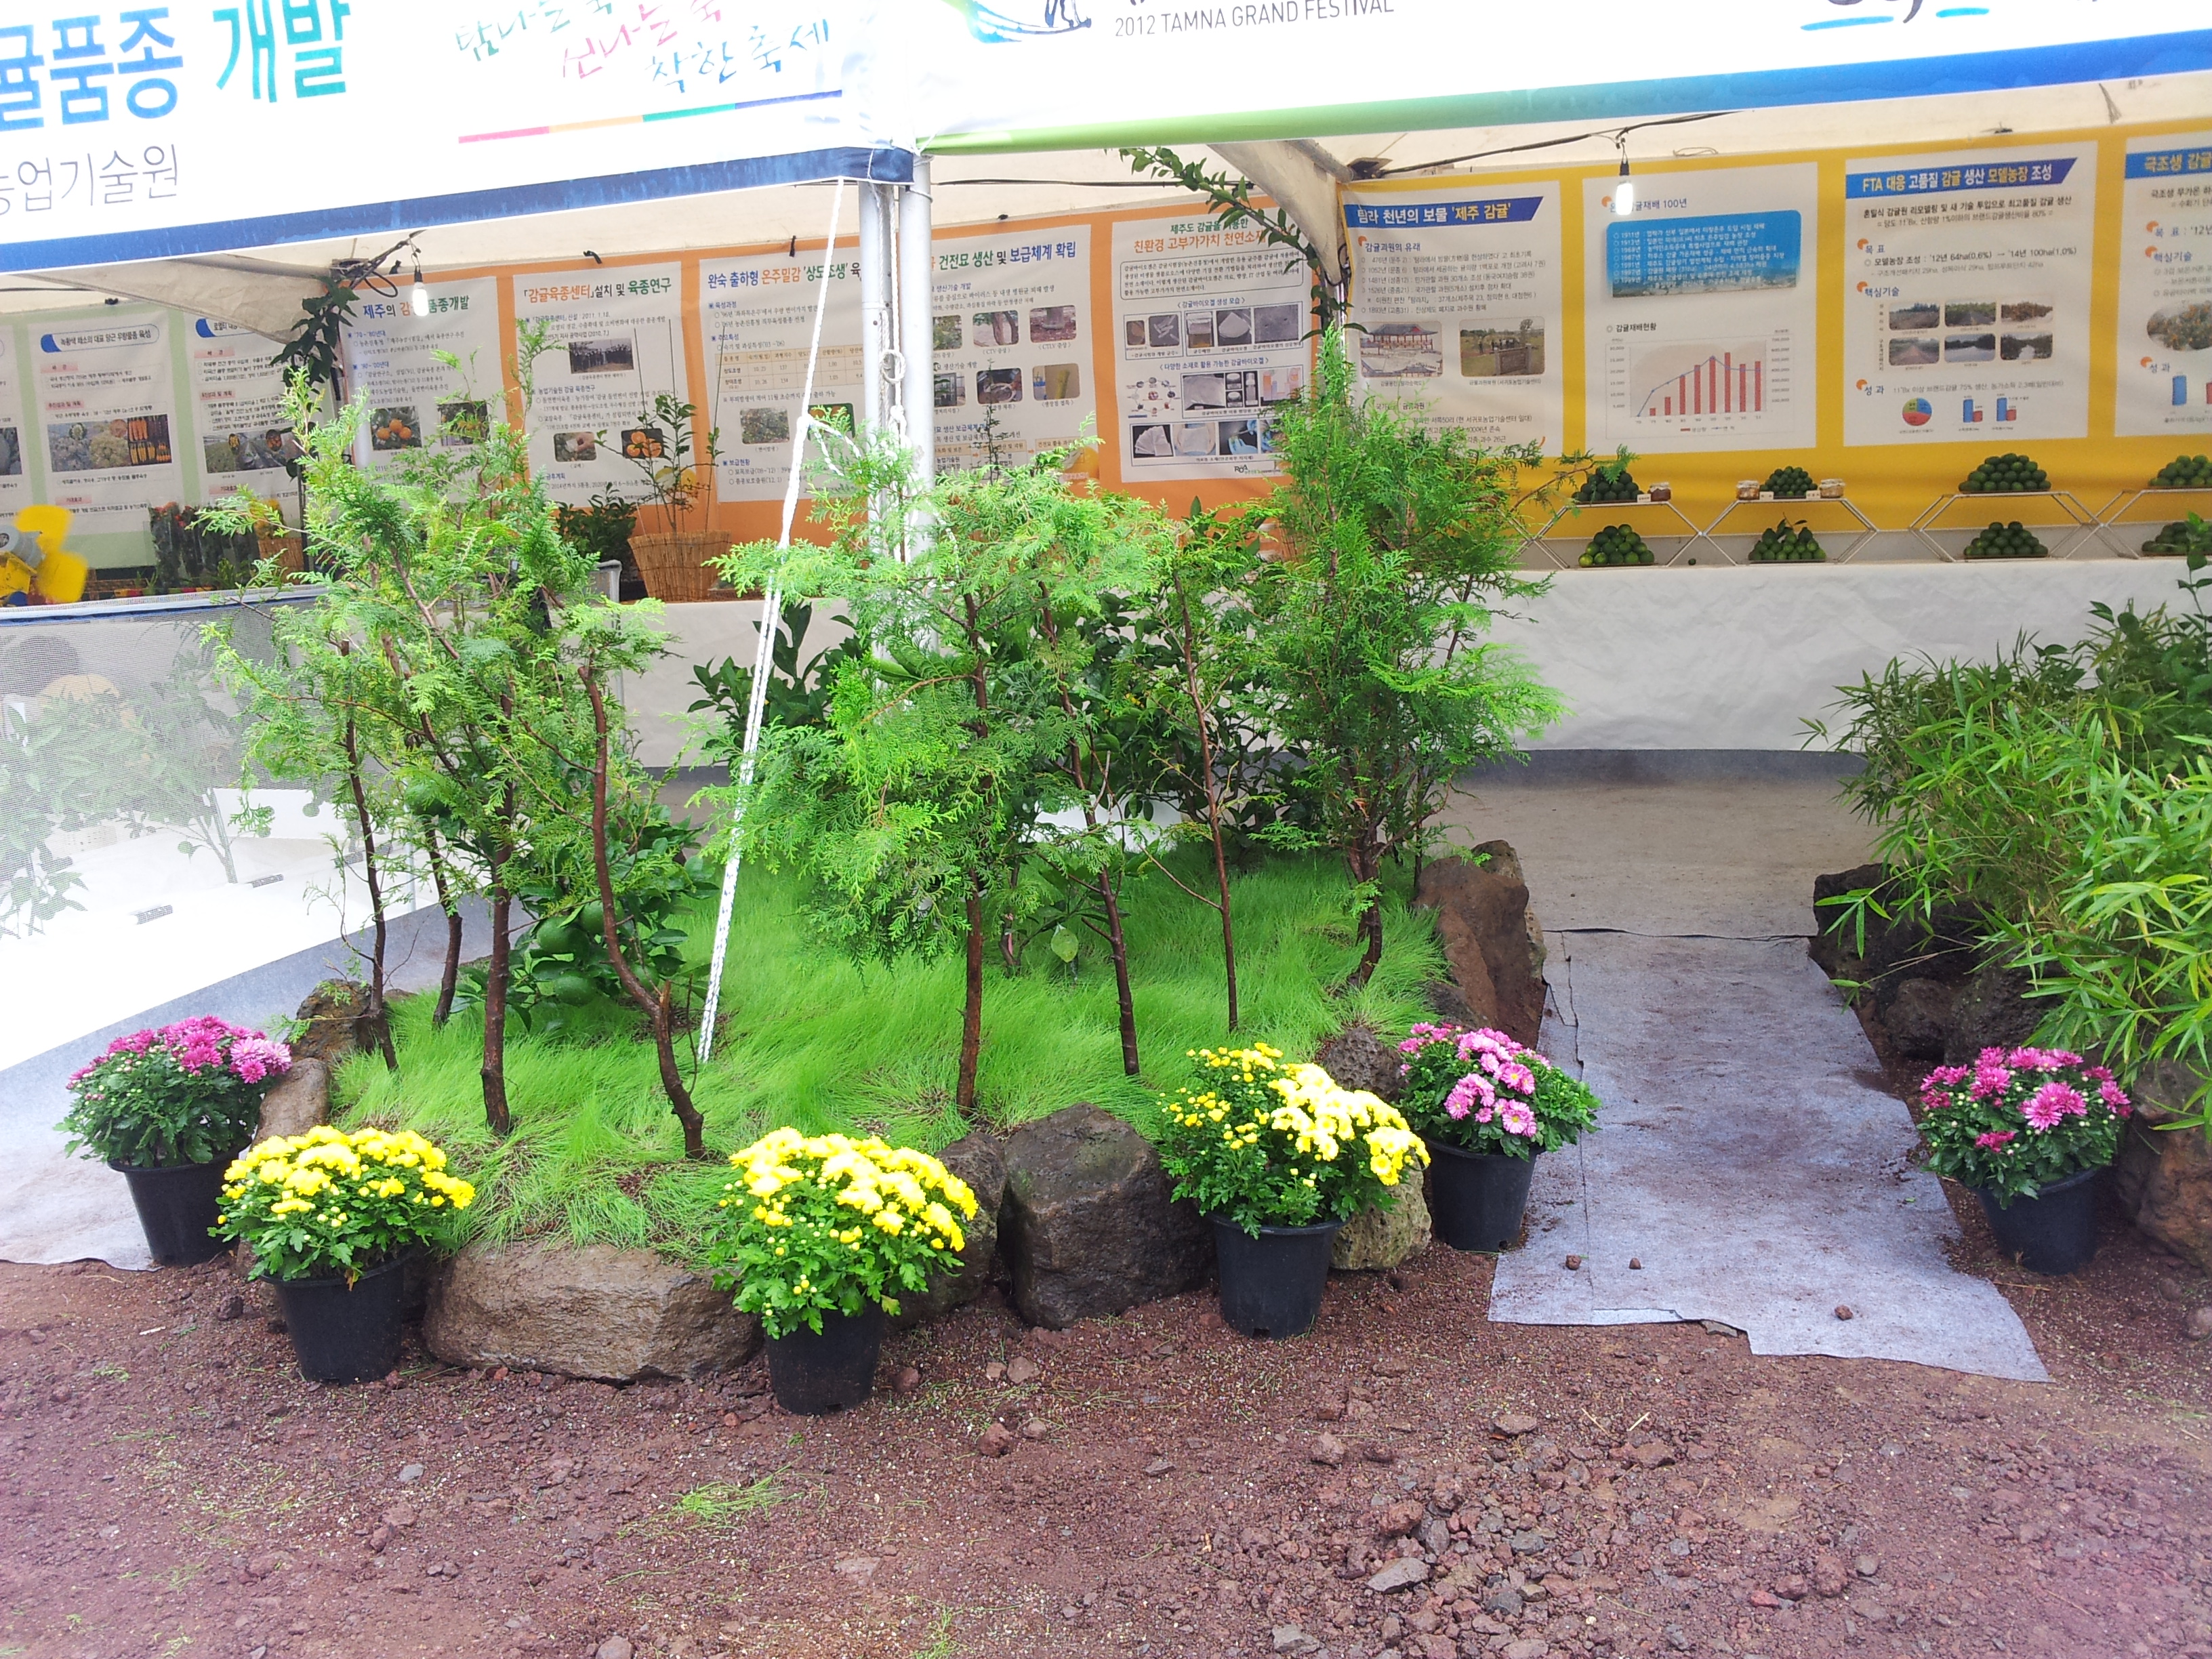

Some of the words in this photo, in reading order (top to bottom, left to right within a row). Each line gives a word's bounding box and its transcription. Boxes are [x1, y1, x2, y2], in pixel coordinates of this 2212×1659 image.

[1115, 16, 1155, 37] 2012
[1162, 9, 1227, 33] TAMNA
[1233, 1, 1299, 27] GRAND
[1305, 0, 1395, 20] FESTIVAL
[213, 0, 351, 102] 개발
[644, 41, 737, 94] 착한
[748, 18, 829, 73] 축제
[1863, 178, 1883, 192] FTA
[1887, 174, 1905, 192] 대응
[1908, 171, 1938, 190] 고품질
[1942, 170, 1961, 187] 감귤
[1965, 167, 1985, 185] 생산
[1988, 166, 2028, 184] 모델농장
[2031, 163, 2052, 181] 조성
[1663, 198, 1687, 209] 100년
[1910, 204, 1938, 214] 리모델링
[1941, 204, 1947, 212] 및
[1961, 202, 1973, 211] 기술
[1977, 200, 2005, 209] 투입으로
[2057, 195, 2072, 205] 생산
[1357, 208, 1378, 224] 탐라
[1383, 208, 1418, 224] 천년의
[1422, 207, 1448, 222] 보물
[1452, 205, 1479, 221] '제주
[1484, 203, 1511, 220] 감귤'
[1170, 223, 1194, 234] 제주도
[1197, 221, 1221, 232] 감귤을
[1134, 239, 1164, 253] 친환경
[1167, 234, 1220, 252] 고부가가치
[1365, 243, 1402, 253] 감귤과원의
[1405, 243, 1420, 252] 유래
[939, 253, 969, 270] 건전묘
[972, 249, 994, 267] 생산
[996, 250, 1006, 265] 및
[1010, 244, 1052, 263] 보급체계
[1055, 241, 1076, 259] 확립
[1875, 256, 1904, 266] 모델농장
[1906, 255, 1921, 264] 조성
[2154, 251, 2192, 263] 핵심기술
[708, 273, 726, 289] 완숙
[730, 269, 758, 288] 출하형
[762, 266, 801, 285] 온주밀감
[616, 283, 625, 297] 및
[628, 277, 672, 295] 육종연구
[961, 282, 971, 290] 개발
[1865, 287, 1900, 298] 핵심기술
[1183, 300, 1215, 308] 감귤바이오겔
[363, 304, 396, 319] 제주의
[1616, 322, 1657, 333] 감귤재배현황
[105, 333, 116, 342] 당근
[139, 329, 151, 338] 육성
[1164, 363, 1181, 371] 다양한
[1183, 361, 1198, 369] 소재로
[1213, 359, 1229, 367] 가능한
[1231, 358, 1264, 367] 감귤바이오겔
